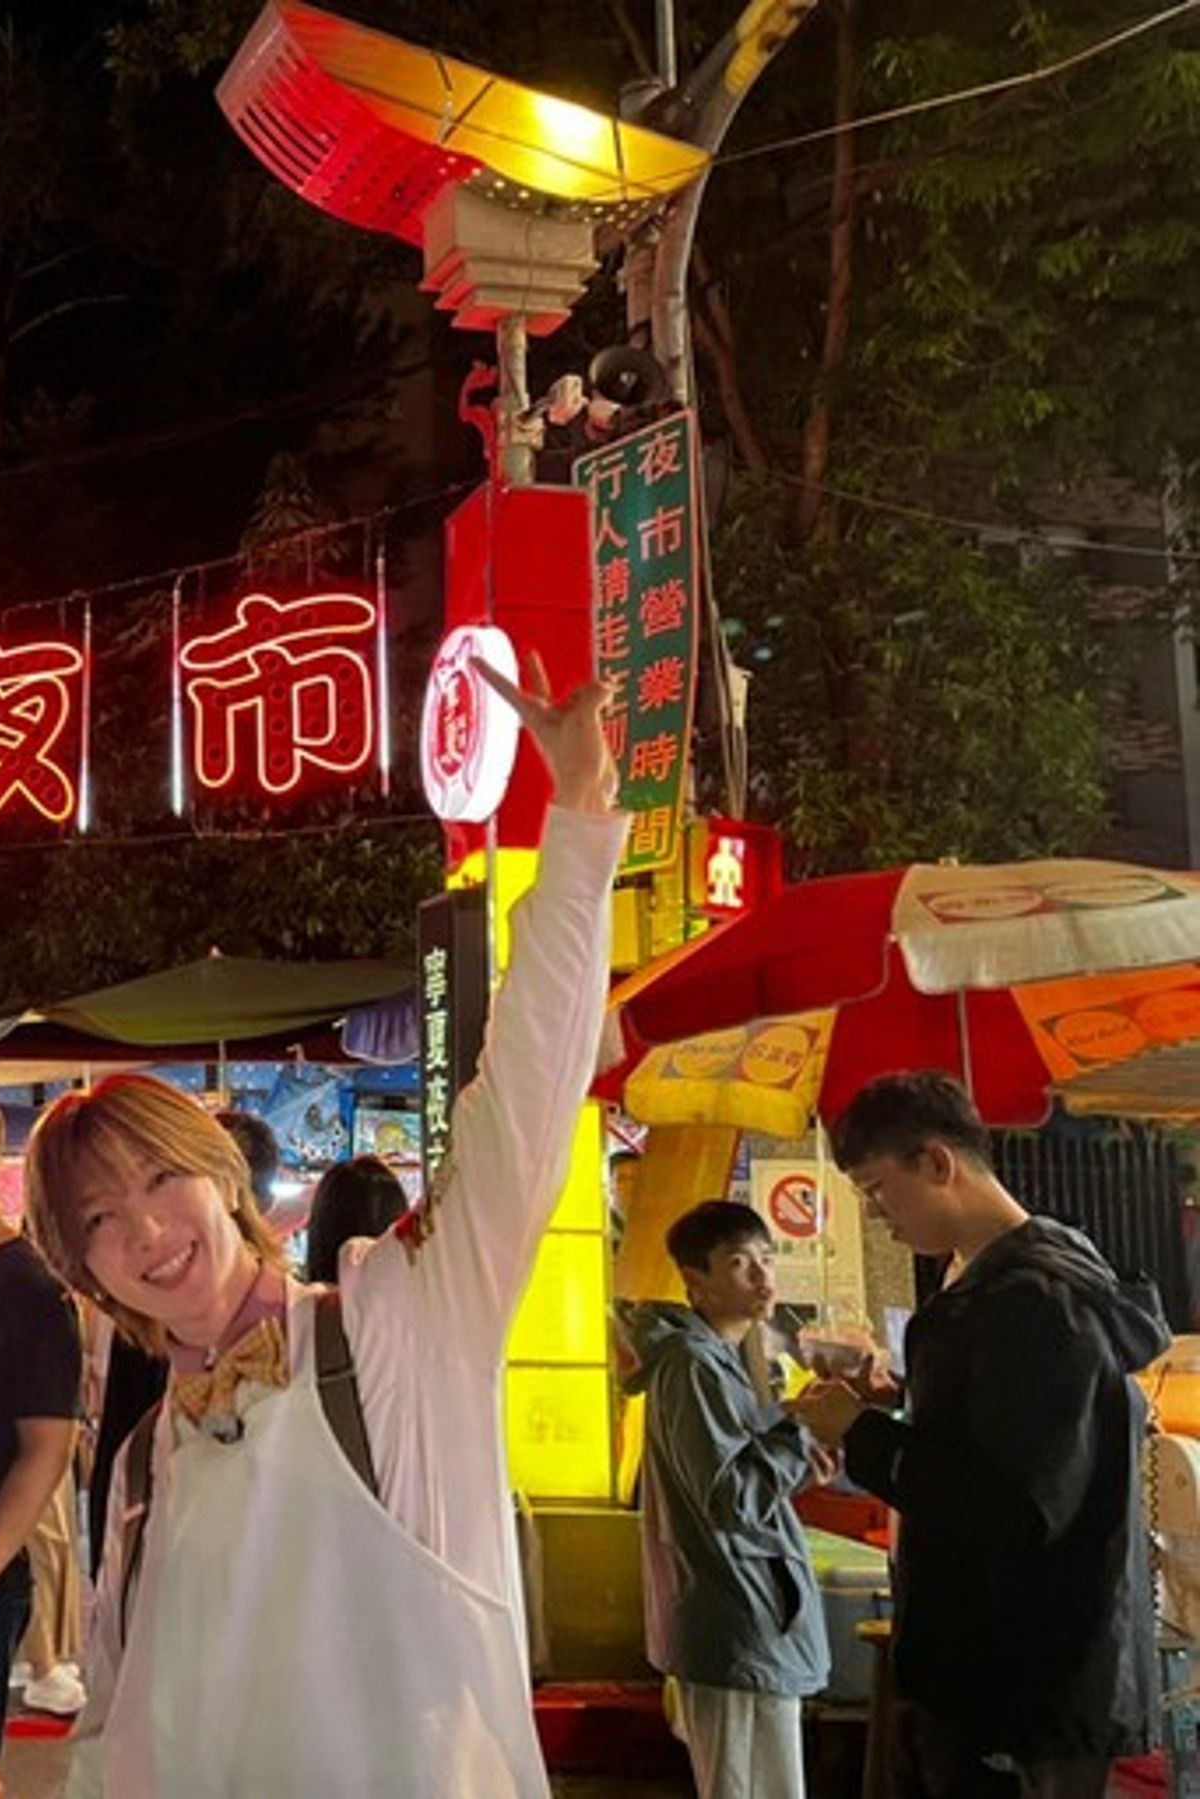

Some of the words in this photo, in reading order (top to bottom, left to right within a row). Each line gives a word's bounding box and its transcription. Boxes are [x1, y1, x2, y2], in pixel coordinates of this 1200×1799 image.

[628, 429, 687, 856] 夜市營業時間
